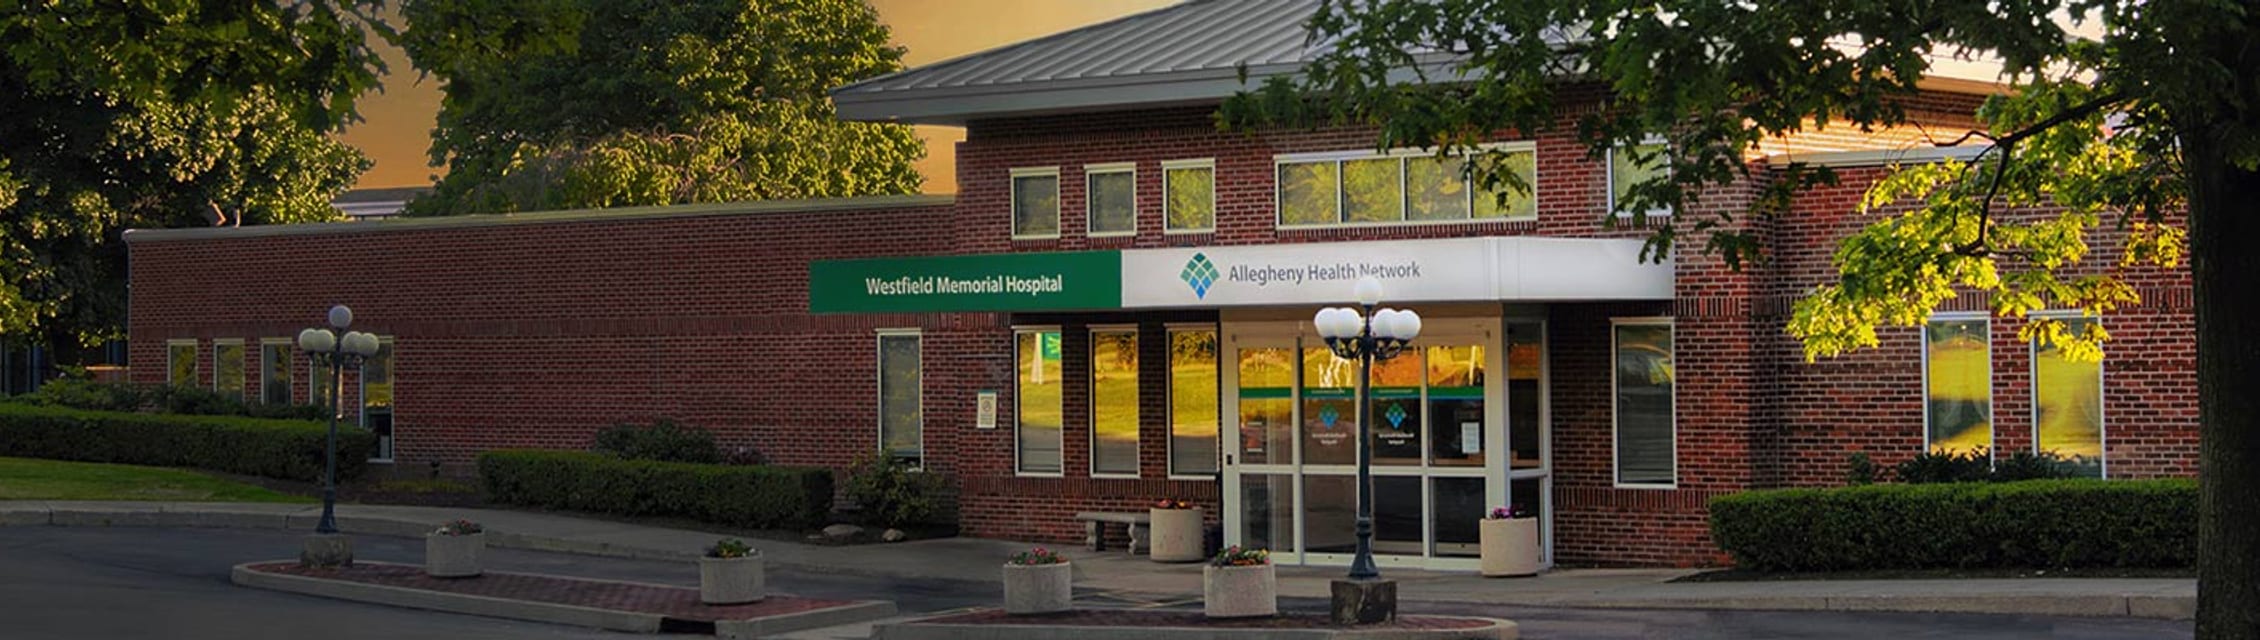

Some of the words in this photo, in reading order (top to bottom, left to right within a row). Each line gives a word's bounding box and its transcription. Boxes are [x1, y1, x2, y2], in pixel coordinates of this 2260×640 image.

[866, 276, 933, 295] Westfield
[936, 275, 1003, 294] Memorial
[1006, 274, 1063, 296] Hospital
[1229, 264, 1304, 286] Allegheny
[1308, 263, 1356, 280] Health
[1360, 261, 1421, 279] Network
